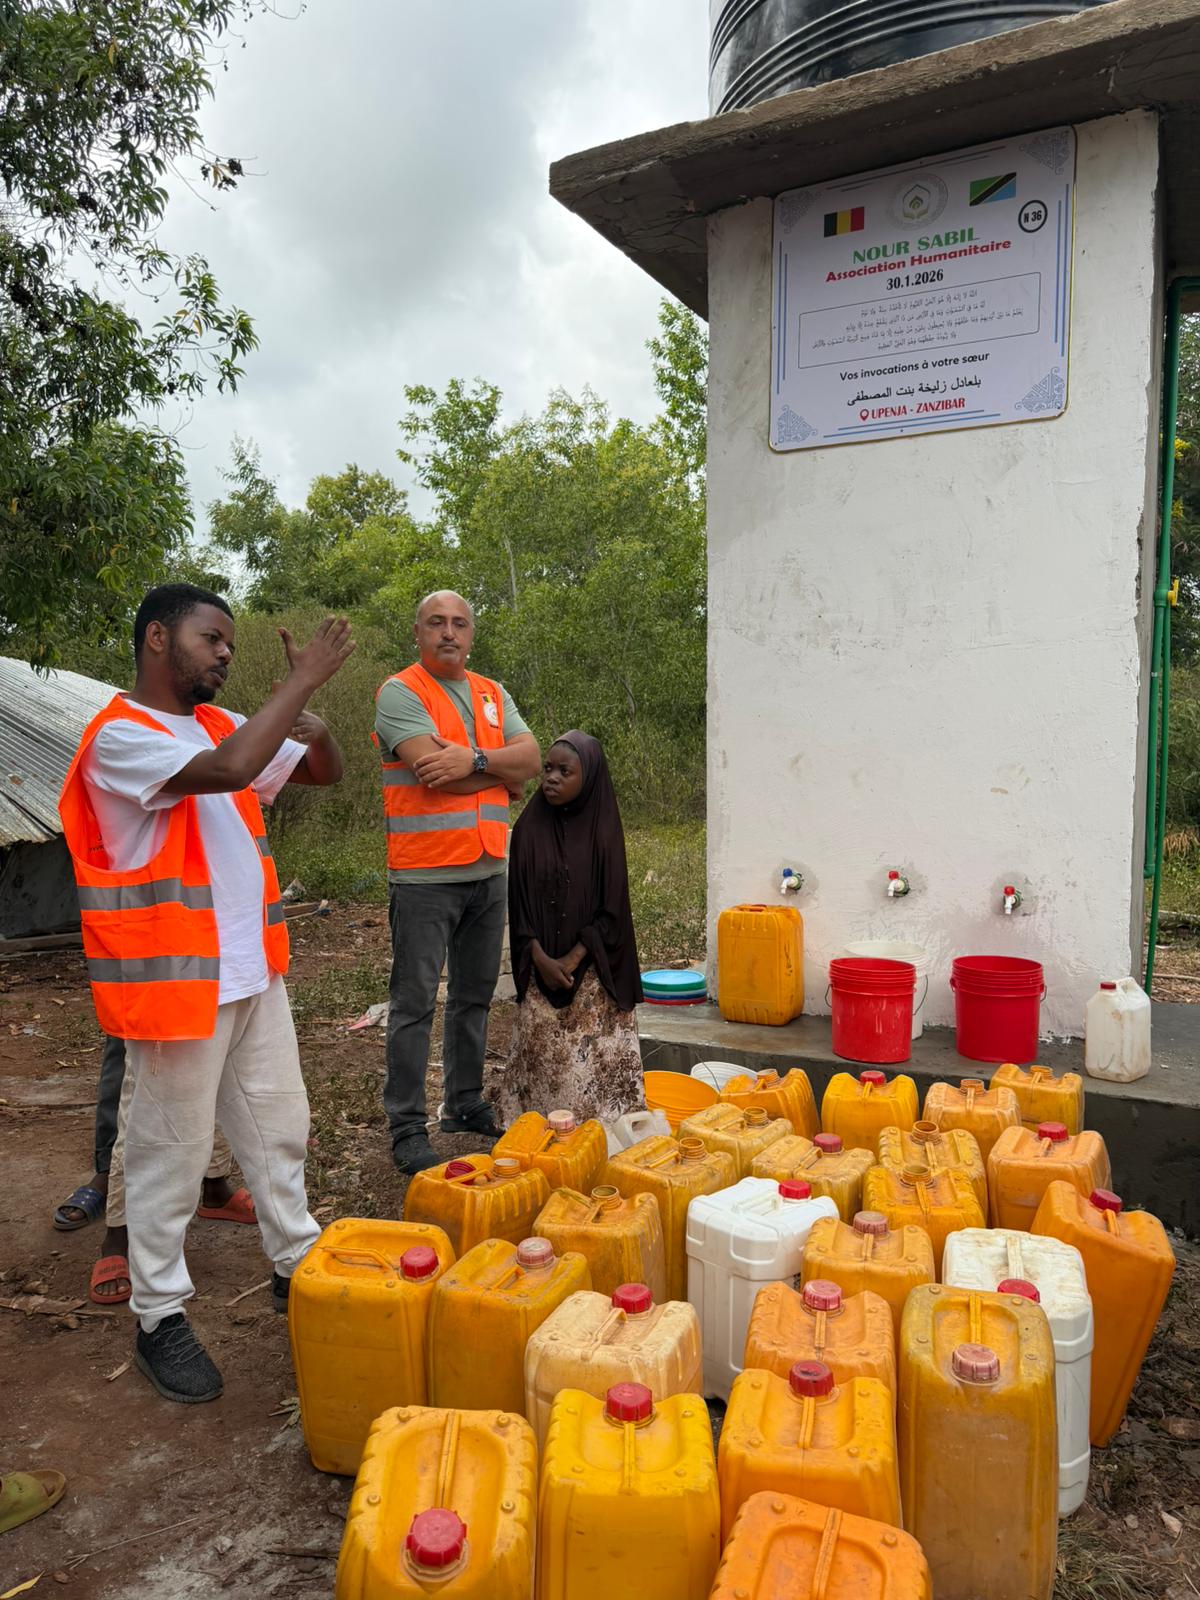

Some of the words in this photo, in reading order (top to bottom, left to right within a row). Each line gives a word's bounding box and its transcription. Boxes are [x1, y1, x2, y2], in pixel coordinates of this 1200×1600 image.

[1031, 210, 1042, 222] 36
[853, 240, 910, 264] NOUR
[917, 227, 980, 251] SABIL
[825, 259, 906, 282] Association
[910, 239, 1012, 266] Humanitaire
[886, 269, 944, 290] 30.1.2026
[840, 371, 858, 381] Vos
[860, 362, 920, 378] invocations
[922, 359, 928, 370] à
[932, 356, 960, 368] votre
[962, 352, 990, 364] sœur
[896, 386, 914, 397] بنت
[918, 380, 947, 394] زليخة
[950, 374, 982, 390] بلعادل
[847, 387, 892, 406] المصطفى
[872, 405, 908, 419] UPENJA
[916, 398, 966, 414] ZANZIBAR
